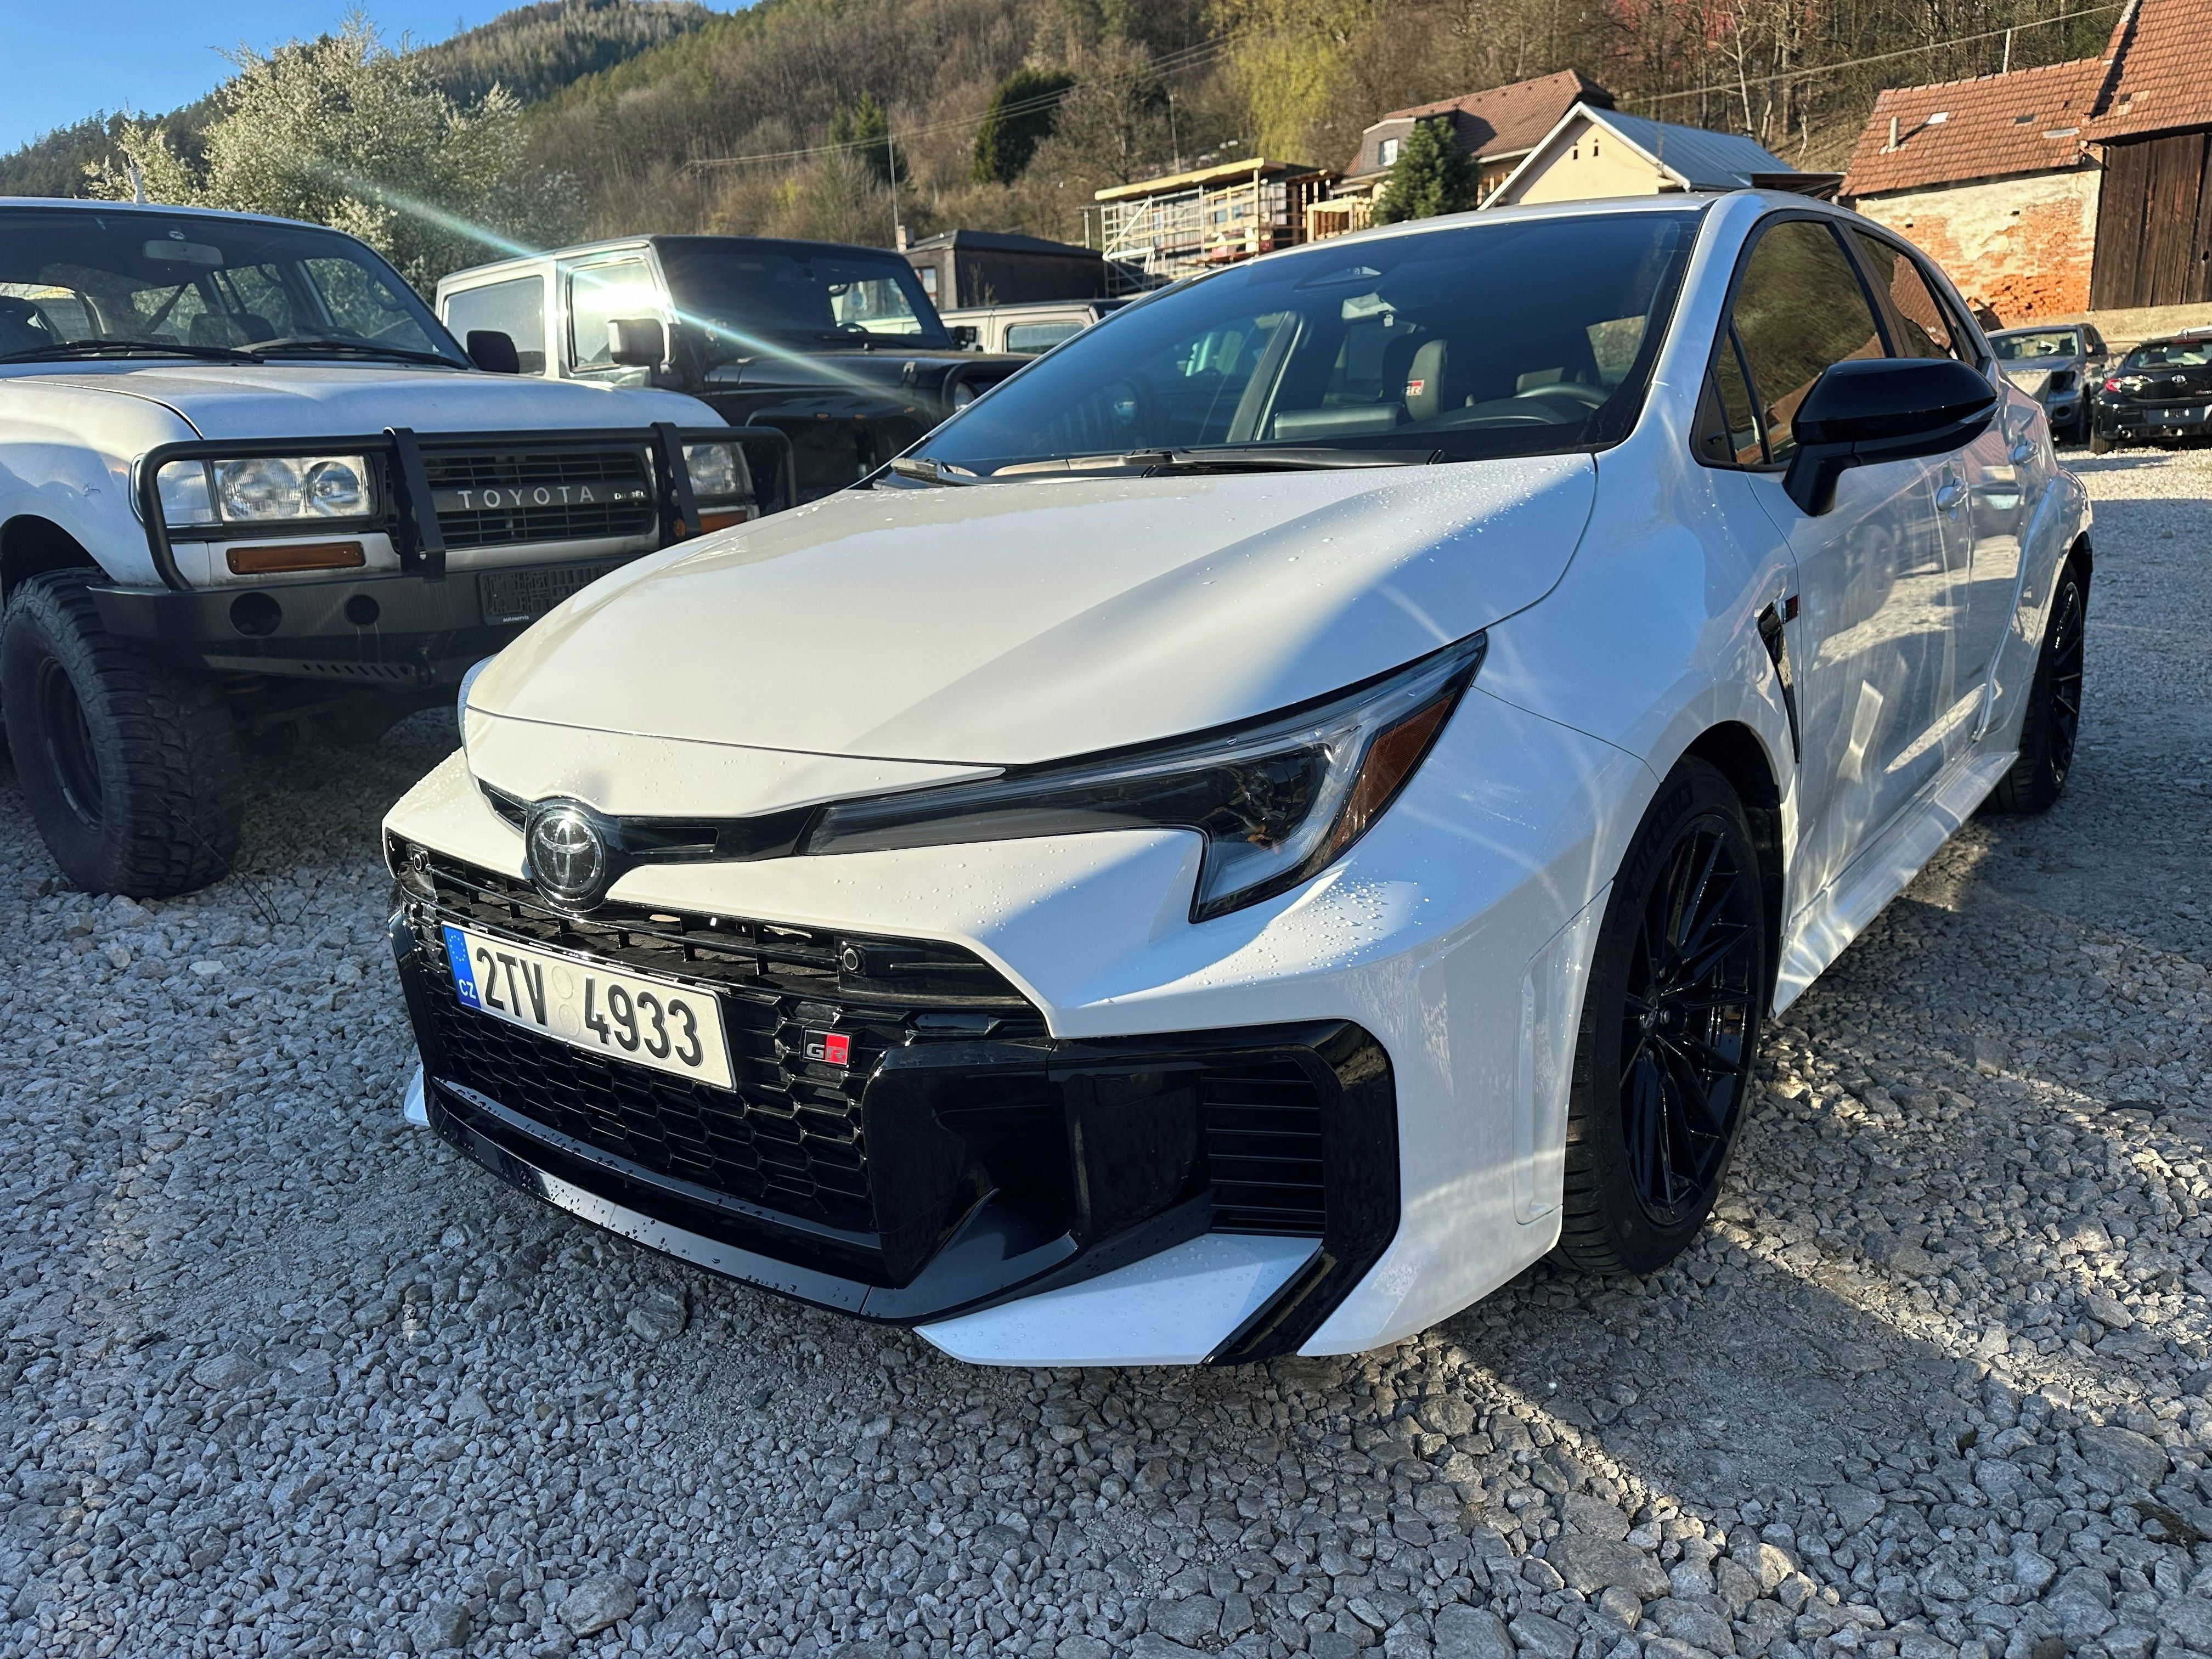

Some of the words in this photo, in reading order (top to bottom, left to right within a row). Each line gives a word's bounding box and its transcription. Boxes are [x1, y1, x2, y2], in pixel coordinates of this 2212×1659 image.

[458, 485, 595, 509] TOYOTA
[459, 978, 477, 1000] CZ
[476, 947, 548, 1026] 2TV
[584, 974, 704, 1068] 4933
[806, 1043, 845, 1063] GR
